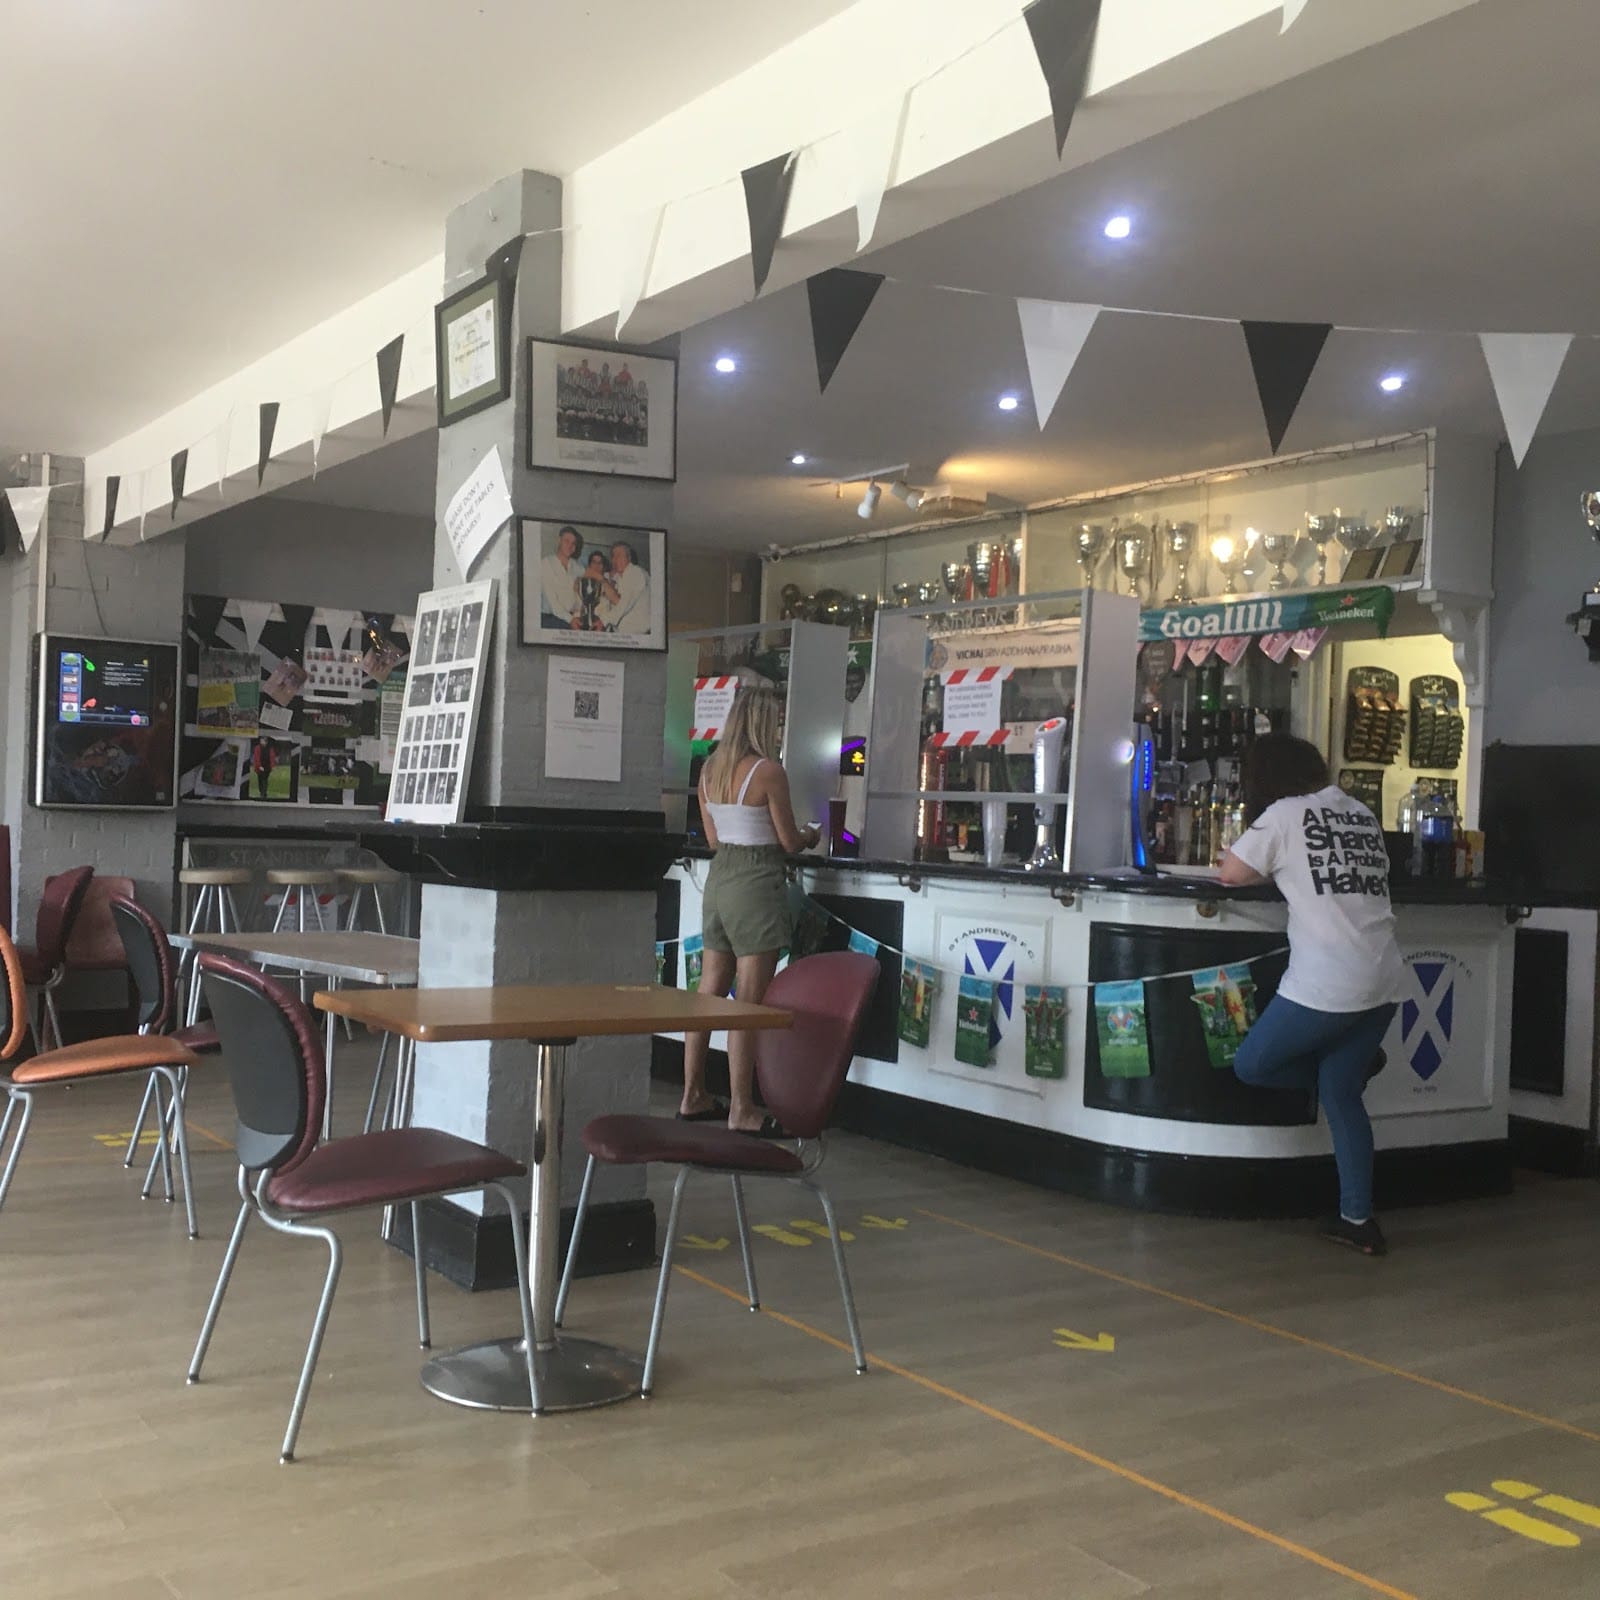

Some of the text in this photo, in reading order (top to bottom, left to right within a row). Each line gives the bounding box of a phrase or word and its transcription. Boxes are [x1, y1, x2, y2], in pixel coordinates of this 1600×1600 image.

[1160, 601, 1283, 637] Goalllll
[956, 648, 983, 660] VICHAI
[1302, 807, 1320, 827] A
[1308, 853, 1324, 868] Is
[1327, 850, 1342, 867] A
[962, 927, 1018, 942] ANDREWS
